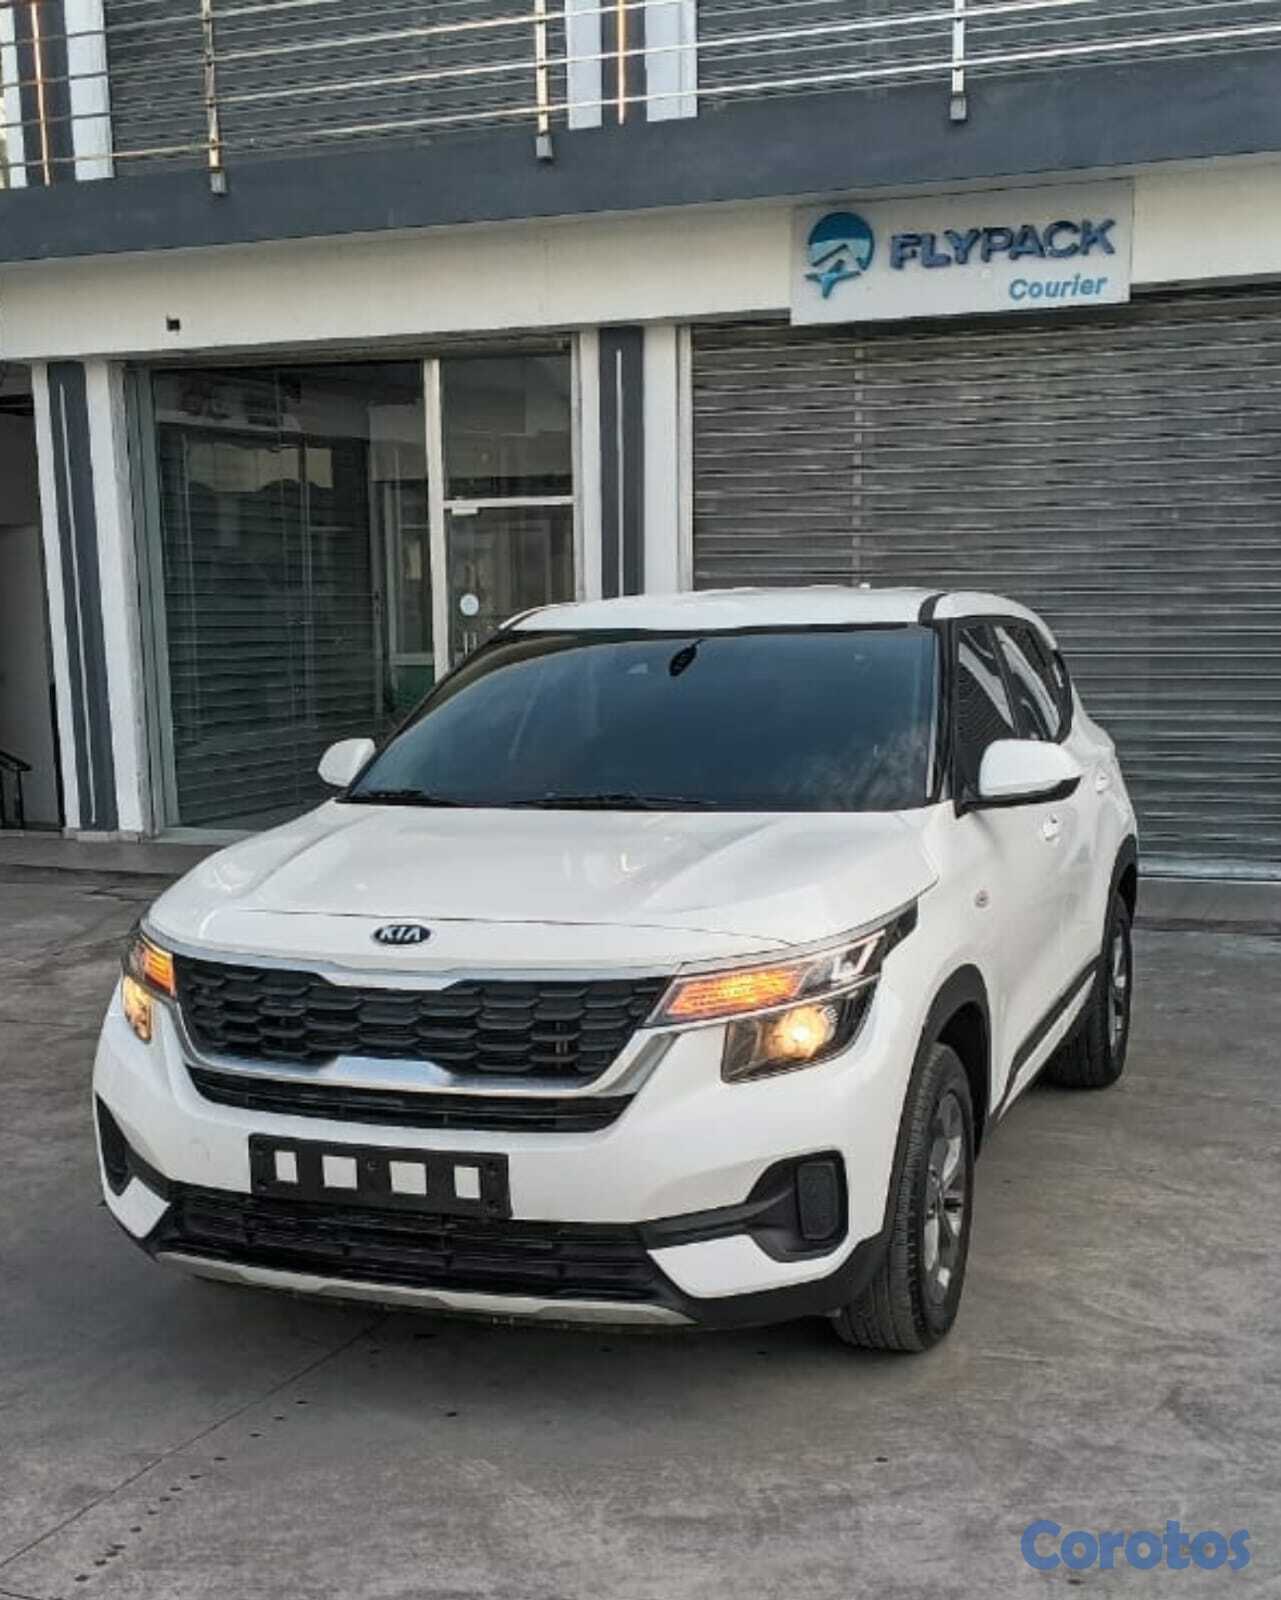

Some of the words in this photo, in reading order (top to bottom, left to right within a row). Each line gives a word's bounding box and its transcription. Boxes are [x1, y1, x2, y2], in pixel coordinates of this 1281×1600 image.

[889, 218, 1116, 270] FLYPACK
[1009, 274, 1108, 301] Courier
[379, 926, 421, 941] KIA
